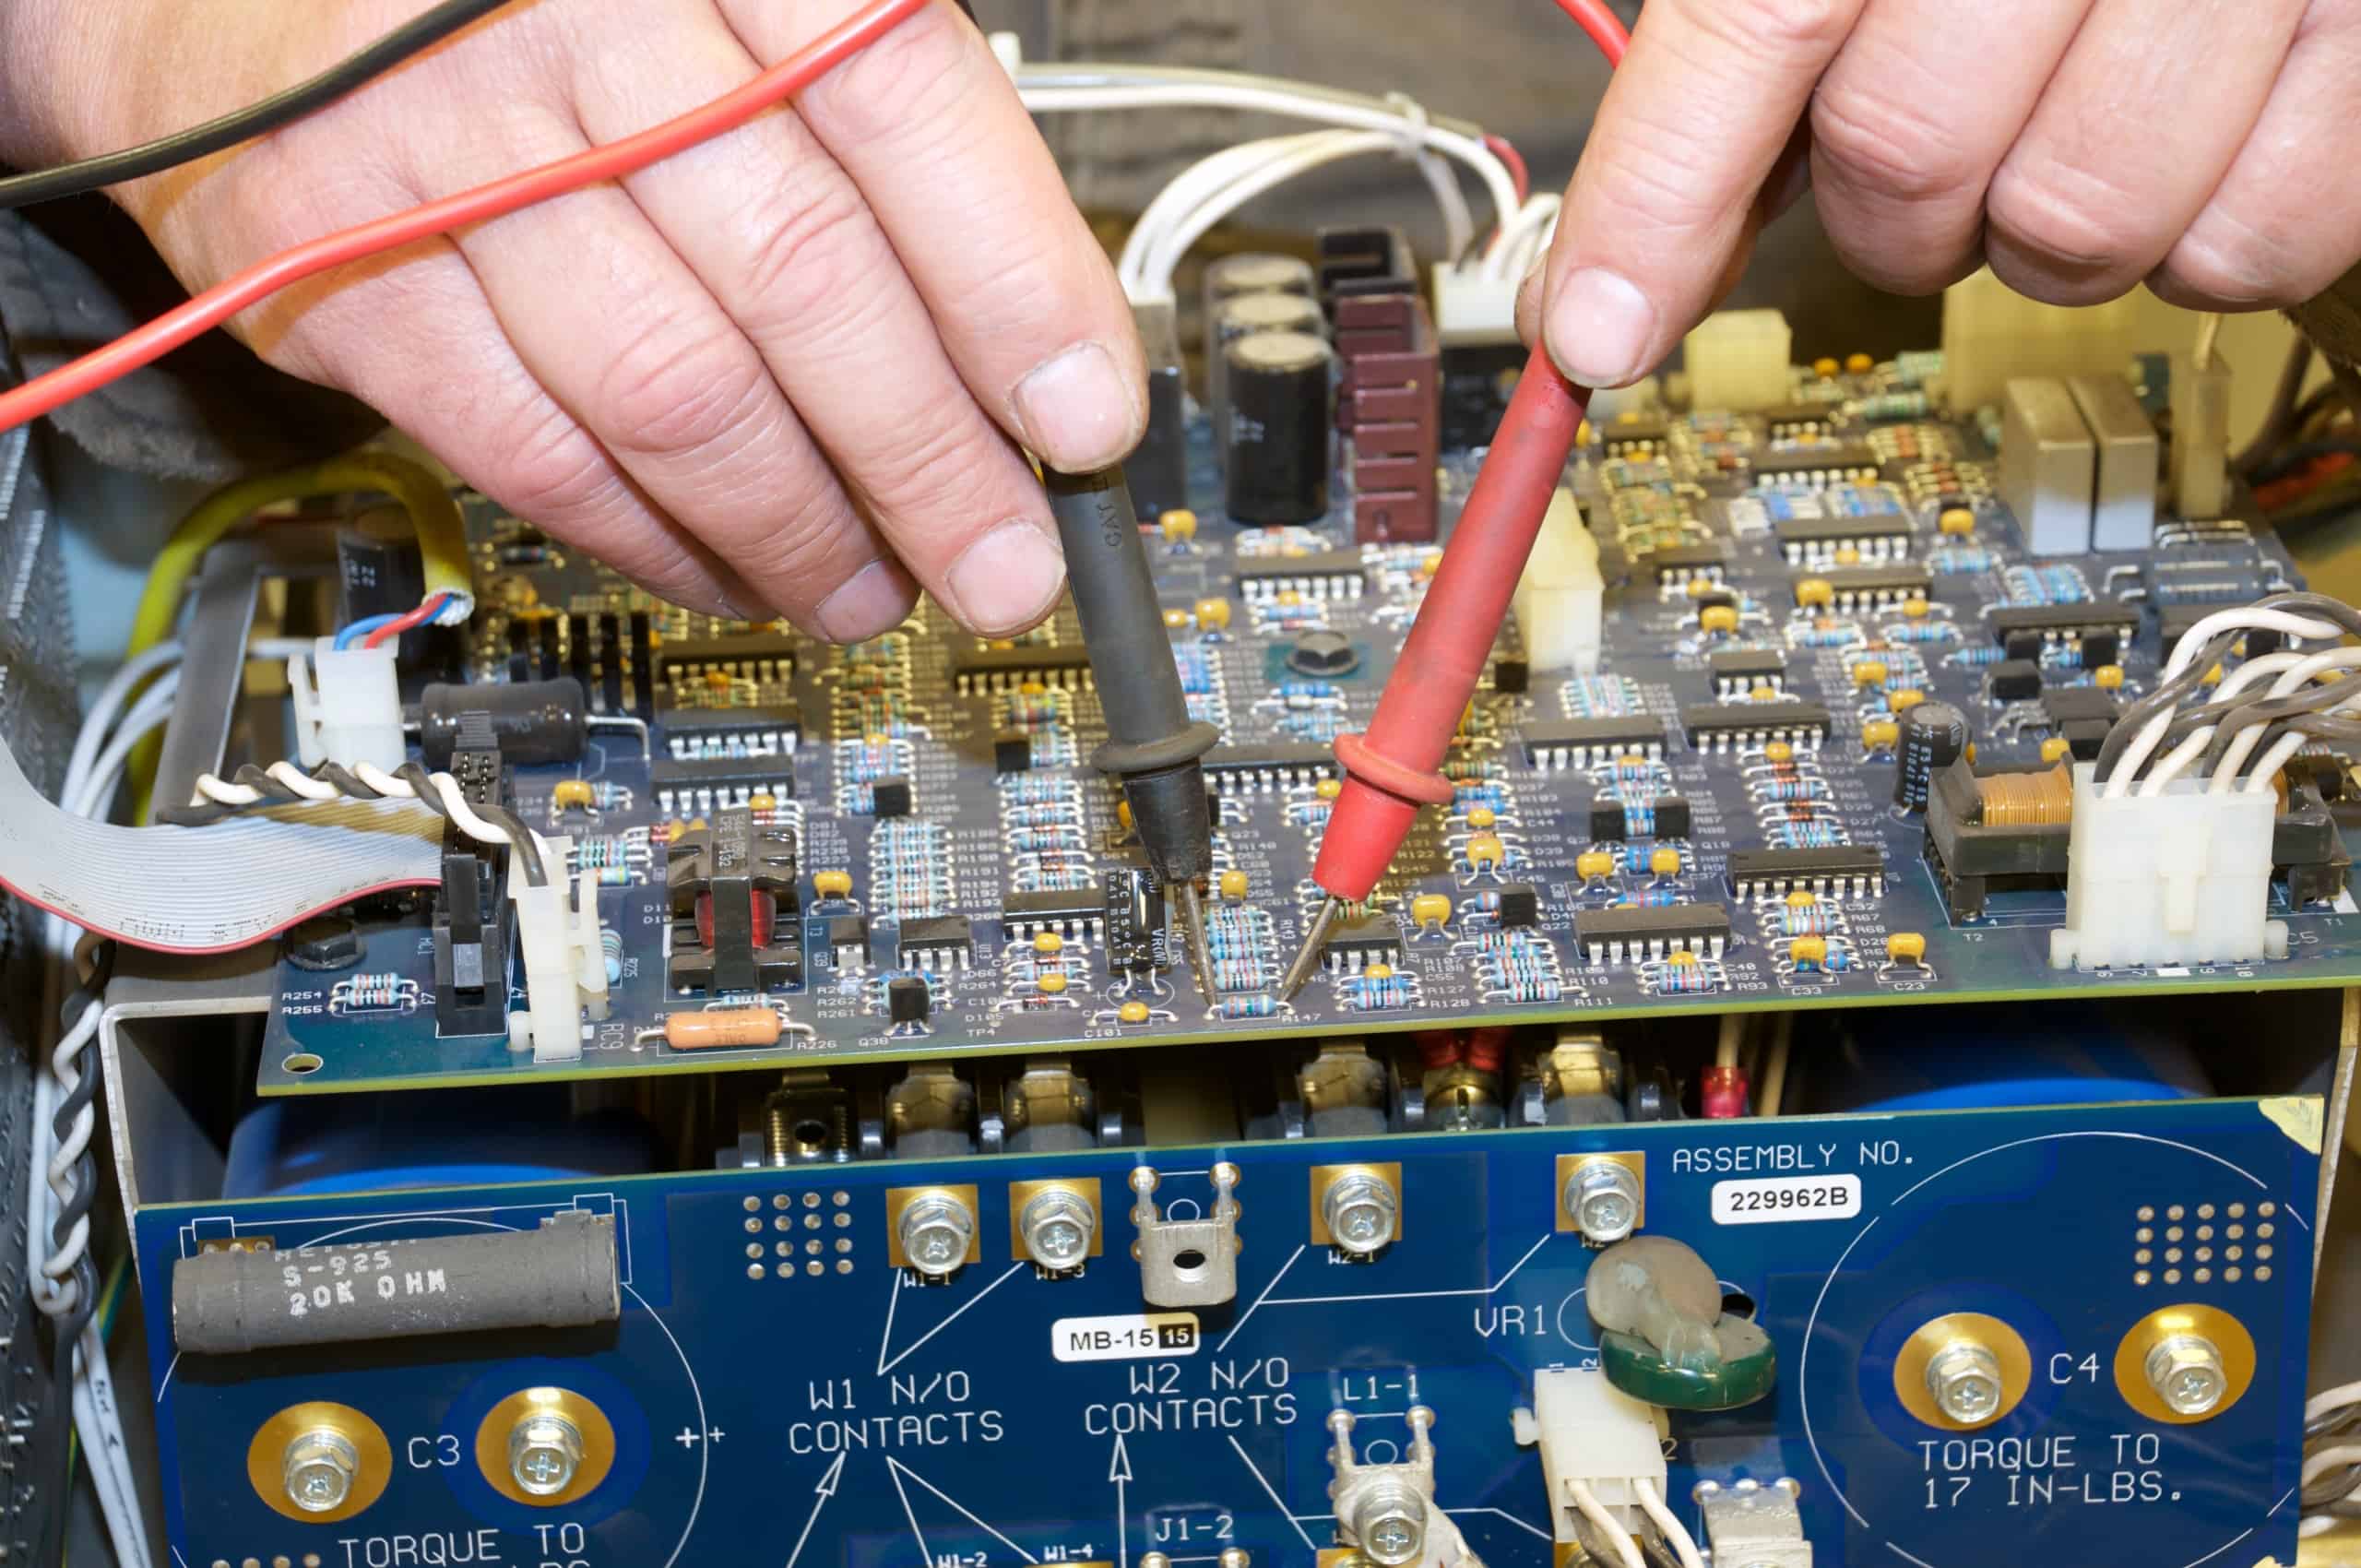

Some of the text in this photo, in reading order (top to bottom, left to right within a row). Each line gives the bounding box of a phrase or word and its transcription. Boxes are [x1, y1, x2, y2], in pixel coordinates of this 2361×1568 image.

[1574, 997, 1614, 1006] R111
[1737, 981, 1769, 991] R93
[1892, 981, 1926, 992] C23
[281, 1004, 323, 1015] R255
[599, 1023, 624, 1050] RC9
[1672, 1140, 1914, 1173] ASSEMBLY NO.
[1729, 1186, 1849, 1212] 229962B
[282, 1249, 392, 1288] S-925
[289, 1267, 447, 1317] 20K OHM
[1475, 1305, 1548, 1338] VR1
[1069, 1327, 1190, 1351] MB-15 15
[1130, 1357, 1290, 1395] W2 N/O
[2048, 1352, 2101, 1384] C4
[809, 1370, 970, 1411] W1 N/O
[1343, 1374, 1420, 1402] L1-1
[1084, 1393, 1298, 1435] CONTACTS
[789, 1409, 1004, 1455] CONTACTS
[409, 1434, 462, 1469] C3
[1917, 1432, 2161, 1473] TORQUE TO
[1924, 1471, 2184, 1510] 17 IN-LBS.
[338, 1521, 586, 1568] TORQUE TO
[1155, 1514, 1235, 1542] J1-2
[1043, 1542, 1095, 1562] W1-4
